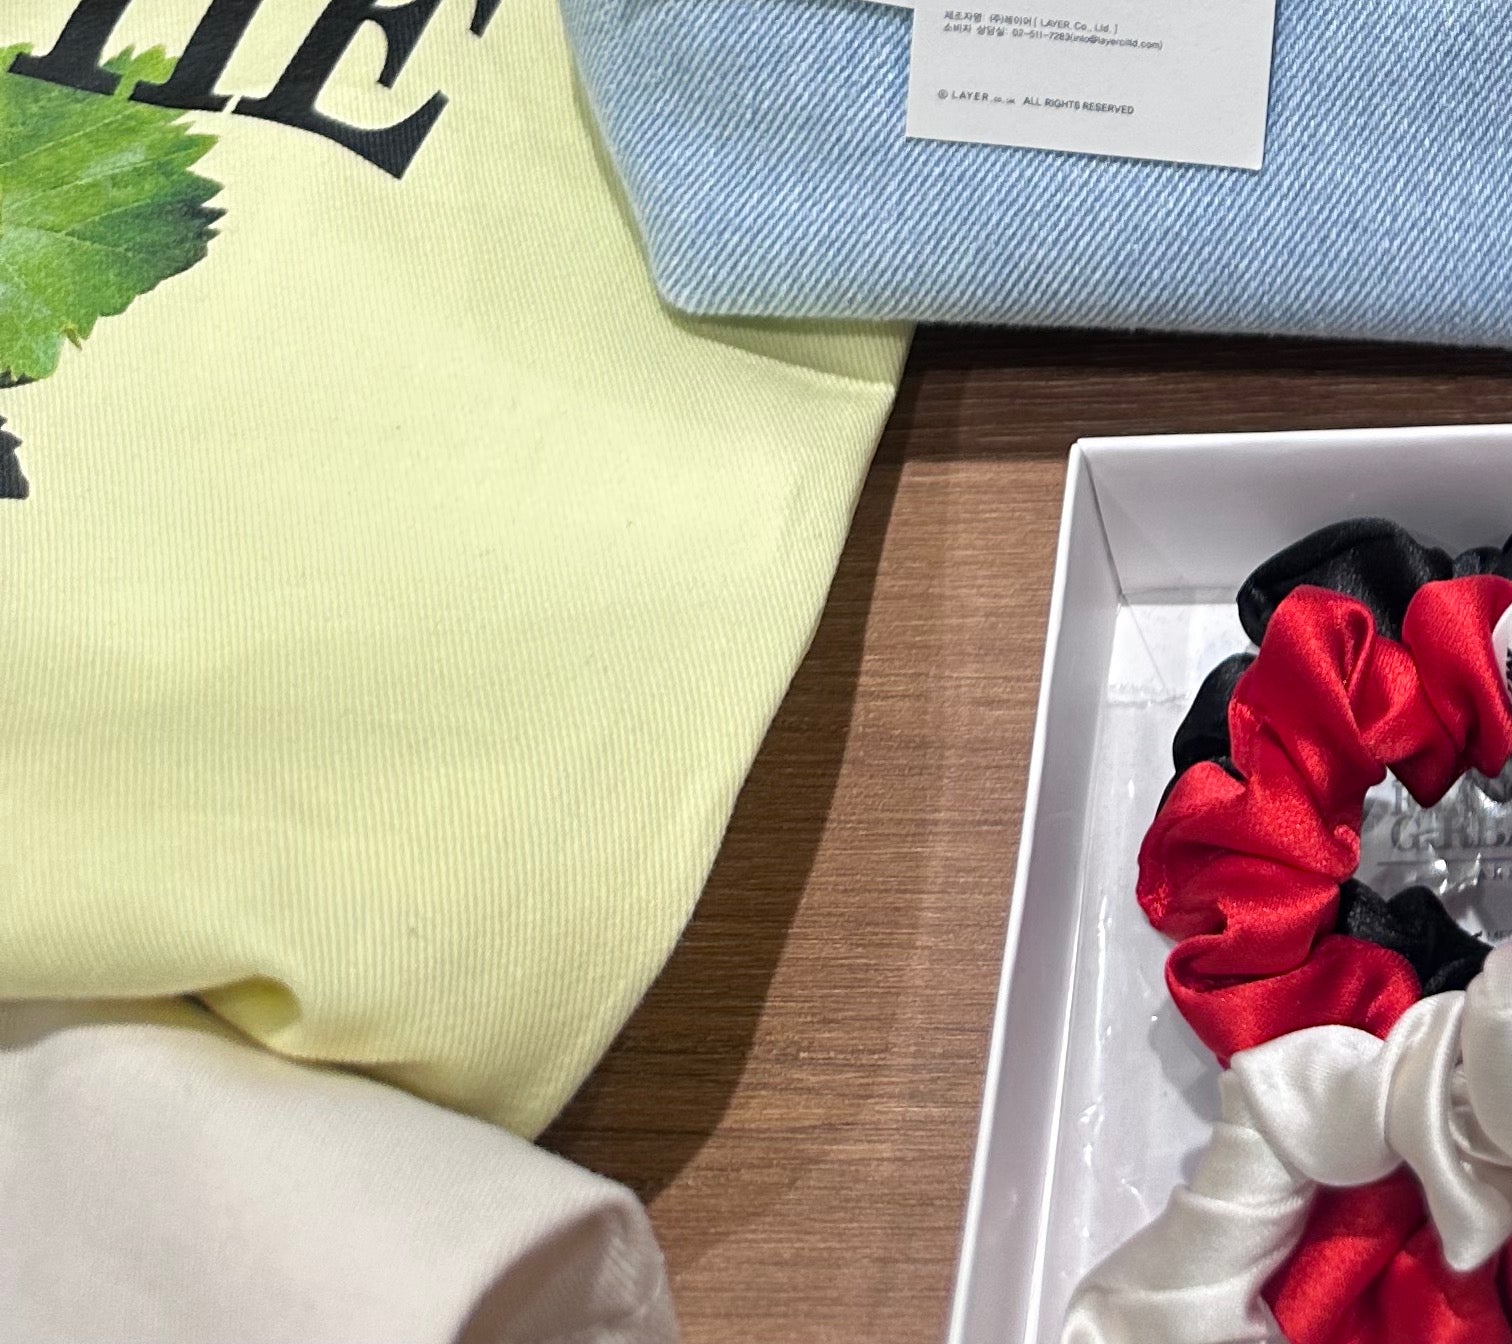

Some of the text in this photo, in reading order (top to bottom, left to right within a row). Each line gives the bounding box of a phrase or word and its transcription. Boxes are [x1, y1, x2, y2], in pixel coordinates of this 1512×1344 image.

[1039, 18, 1072, 29] LAYER
[950, 89, 989, 102] LAYER
[1021, 95, 1042, 107] ALL
[1043, 97, 1080, 111] RIGHTS
[1081, 101, 1134, 116] RESERVED
